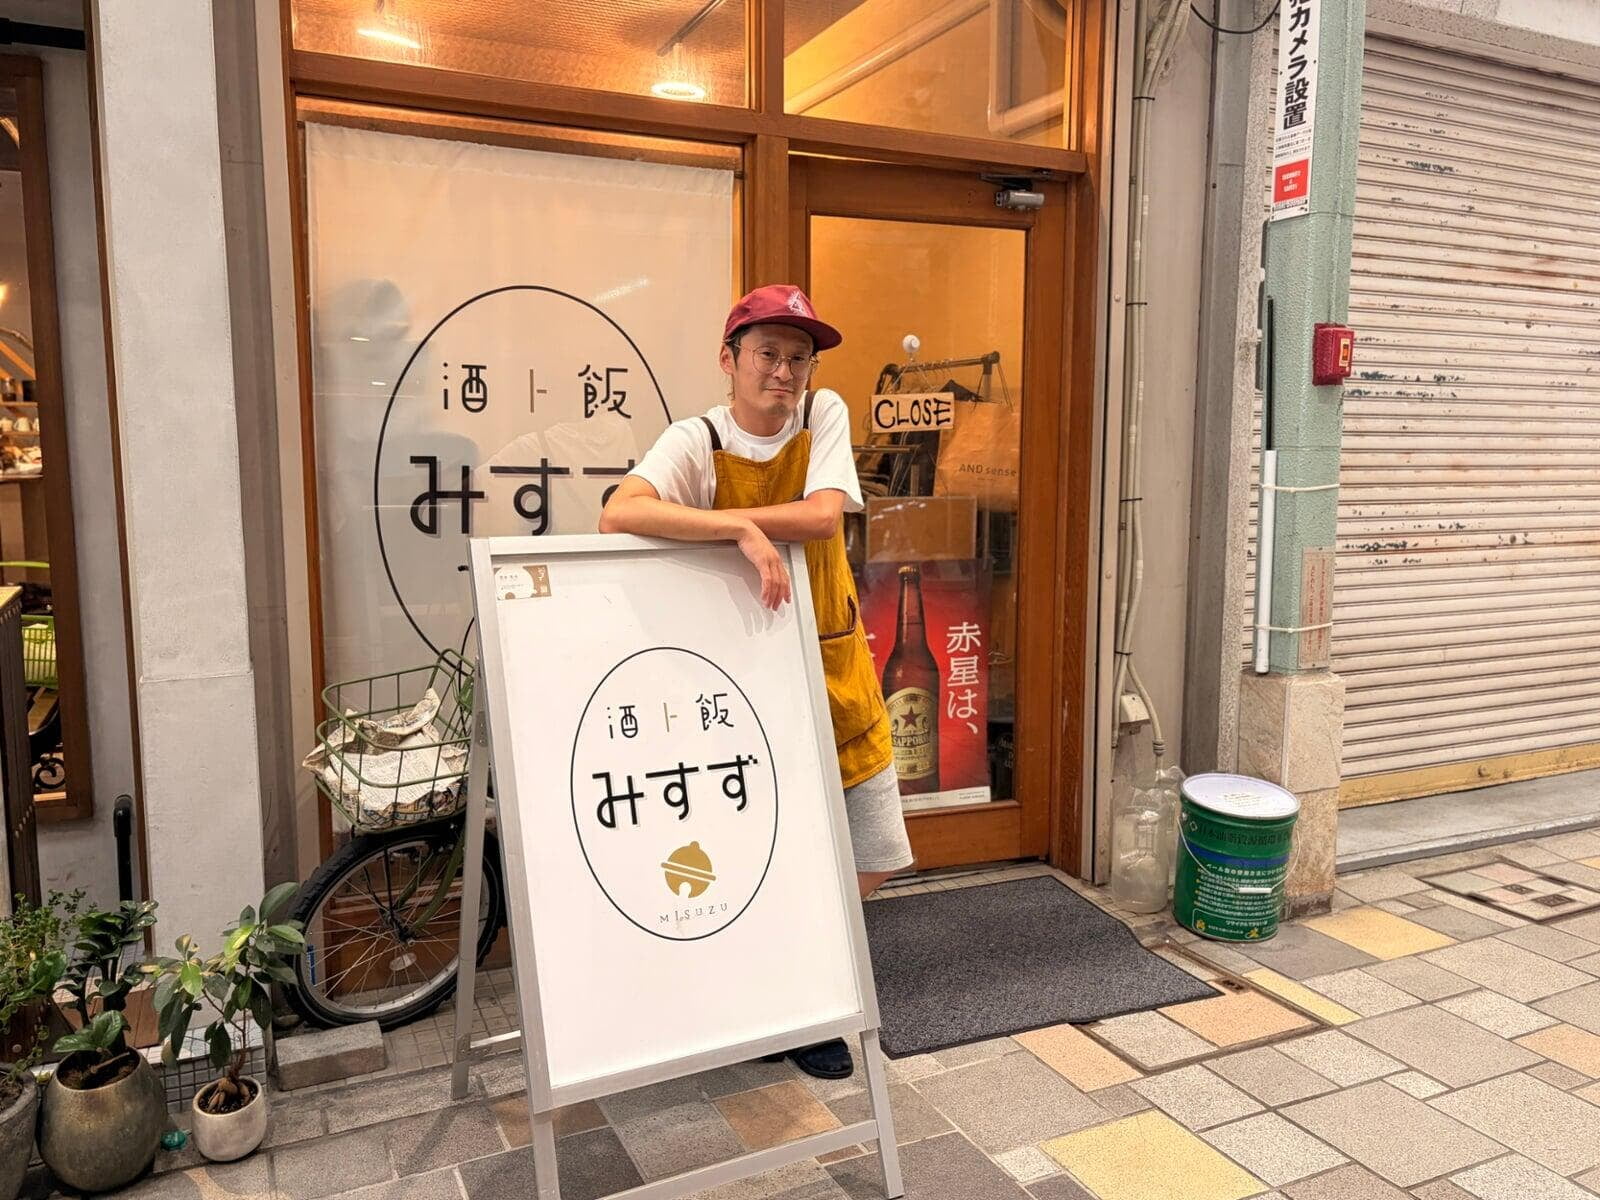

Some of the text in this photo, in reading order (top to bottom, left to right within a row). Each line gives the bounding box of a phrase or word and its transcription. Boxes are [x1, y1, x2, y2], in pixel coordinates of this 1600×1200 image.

[874, 397, 951, 429] CLOSE
[958, 463, 983, 474] AND
[946, 621, 982, 735] 赤星は、
[592, 754, 759, 829] みすず
[660, 903, 728, 923] MISUZU
